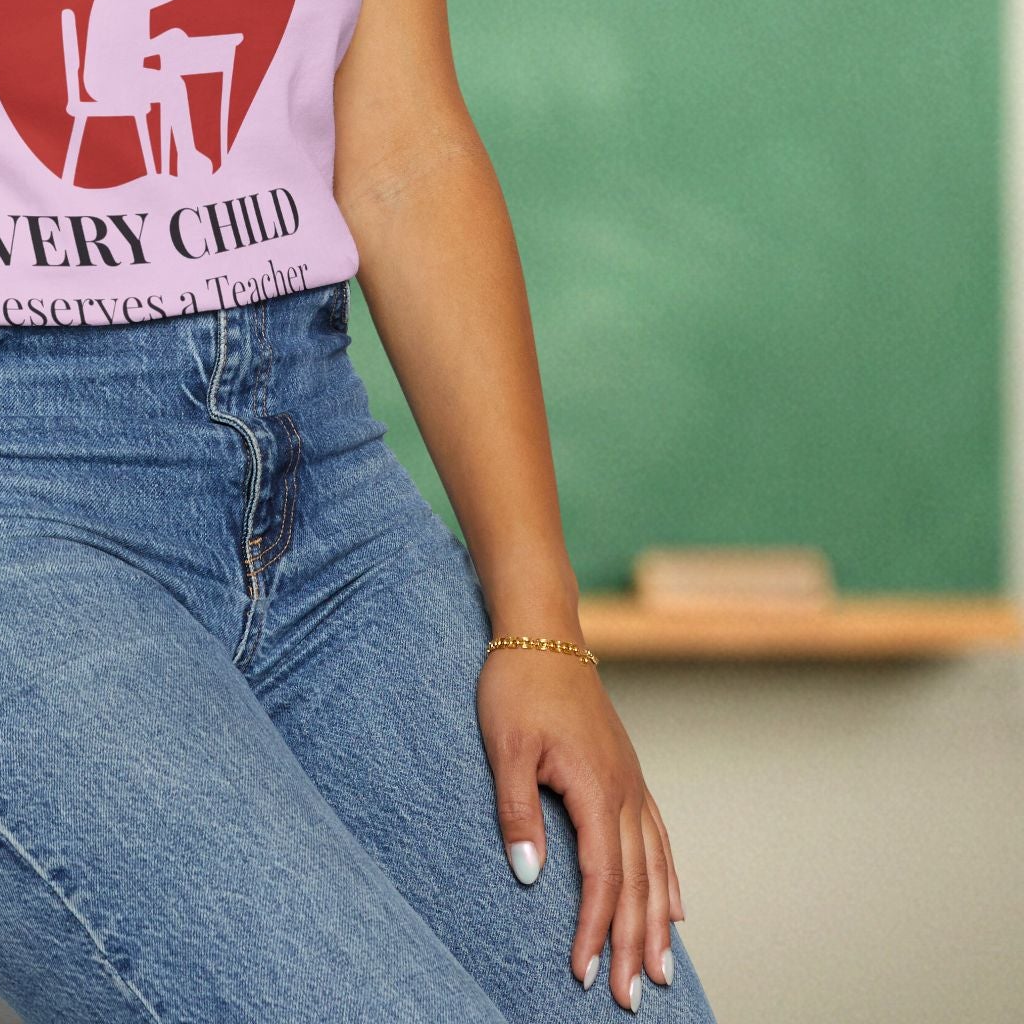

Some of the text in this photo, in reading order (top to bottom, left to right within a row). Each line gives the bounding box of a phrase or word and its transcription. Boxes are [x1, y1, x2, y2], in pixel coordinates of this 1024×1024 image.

[168, 187, 300, 260] CHILD
[180, 290, 198, 315] a
[205, 259, 309, 309] Teacher
